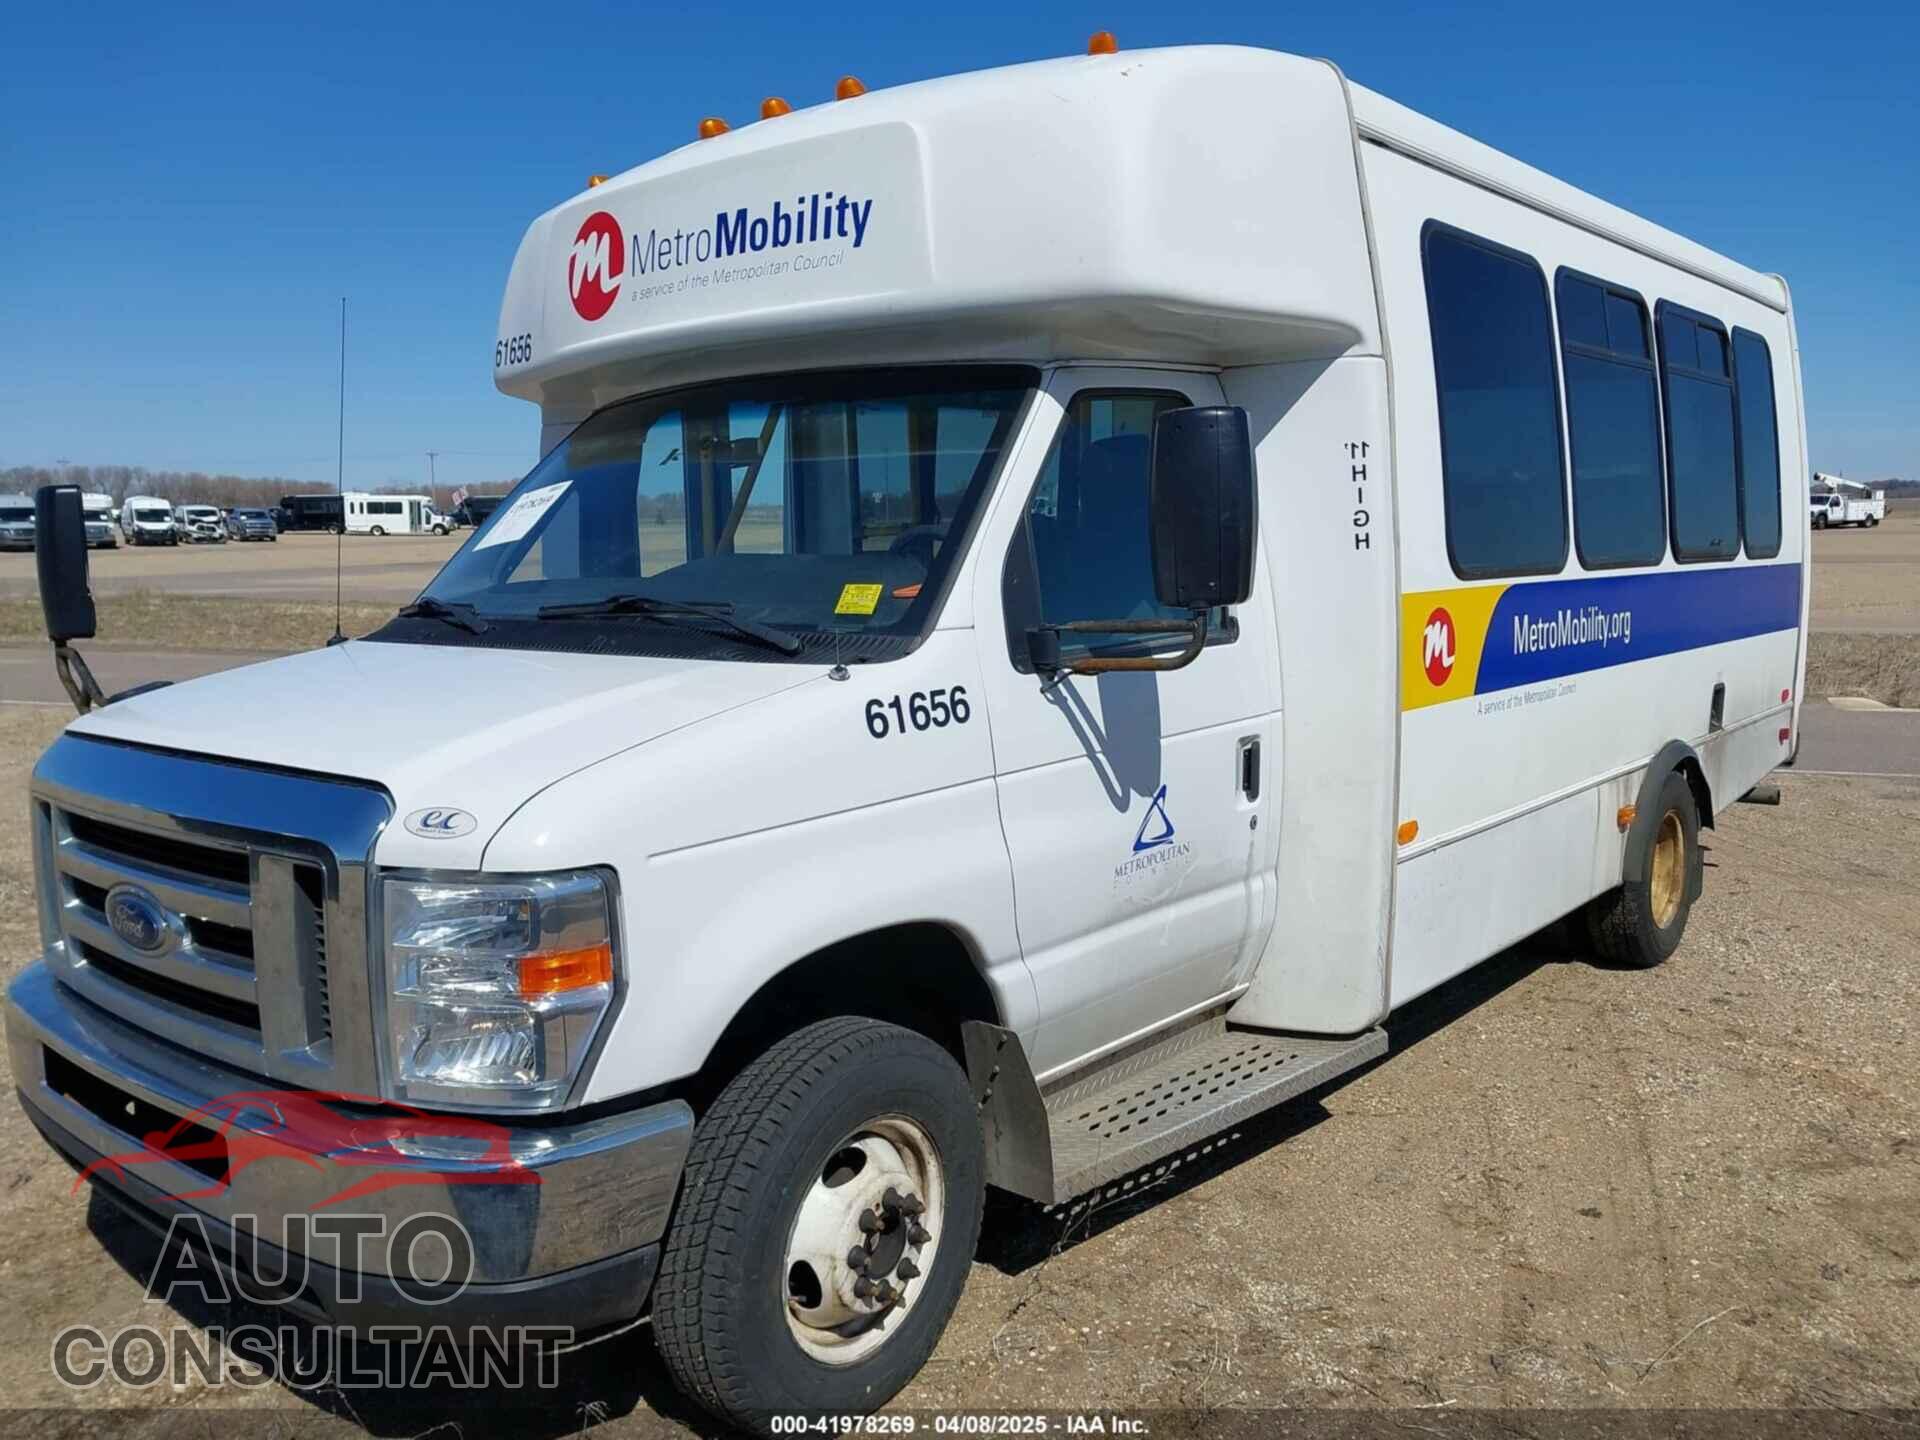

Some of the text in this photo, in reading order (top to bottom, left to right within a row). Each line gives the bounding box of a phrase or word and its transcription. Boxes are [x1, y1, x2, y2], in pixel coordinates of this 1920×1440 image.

[631, 191, 873, 278] MetroMobility
[631, 249, 845, 302] a service of the Metropolitan Council
[495, 333, 532, 368] 61656
[1514, 605, 1631, 655] MetroMobility.org
[865, 684, 971, 739] 61656
[1113, 840, 1191, 878] METROPOLITAN
